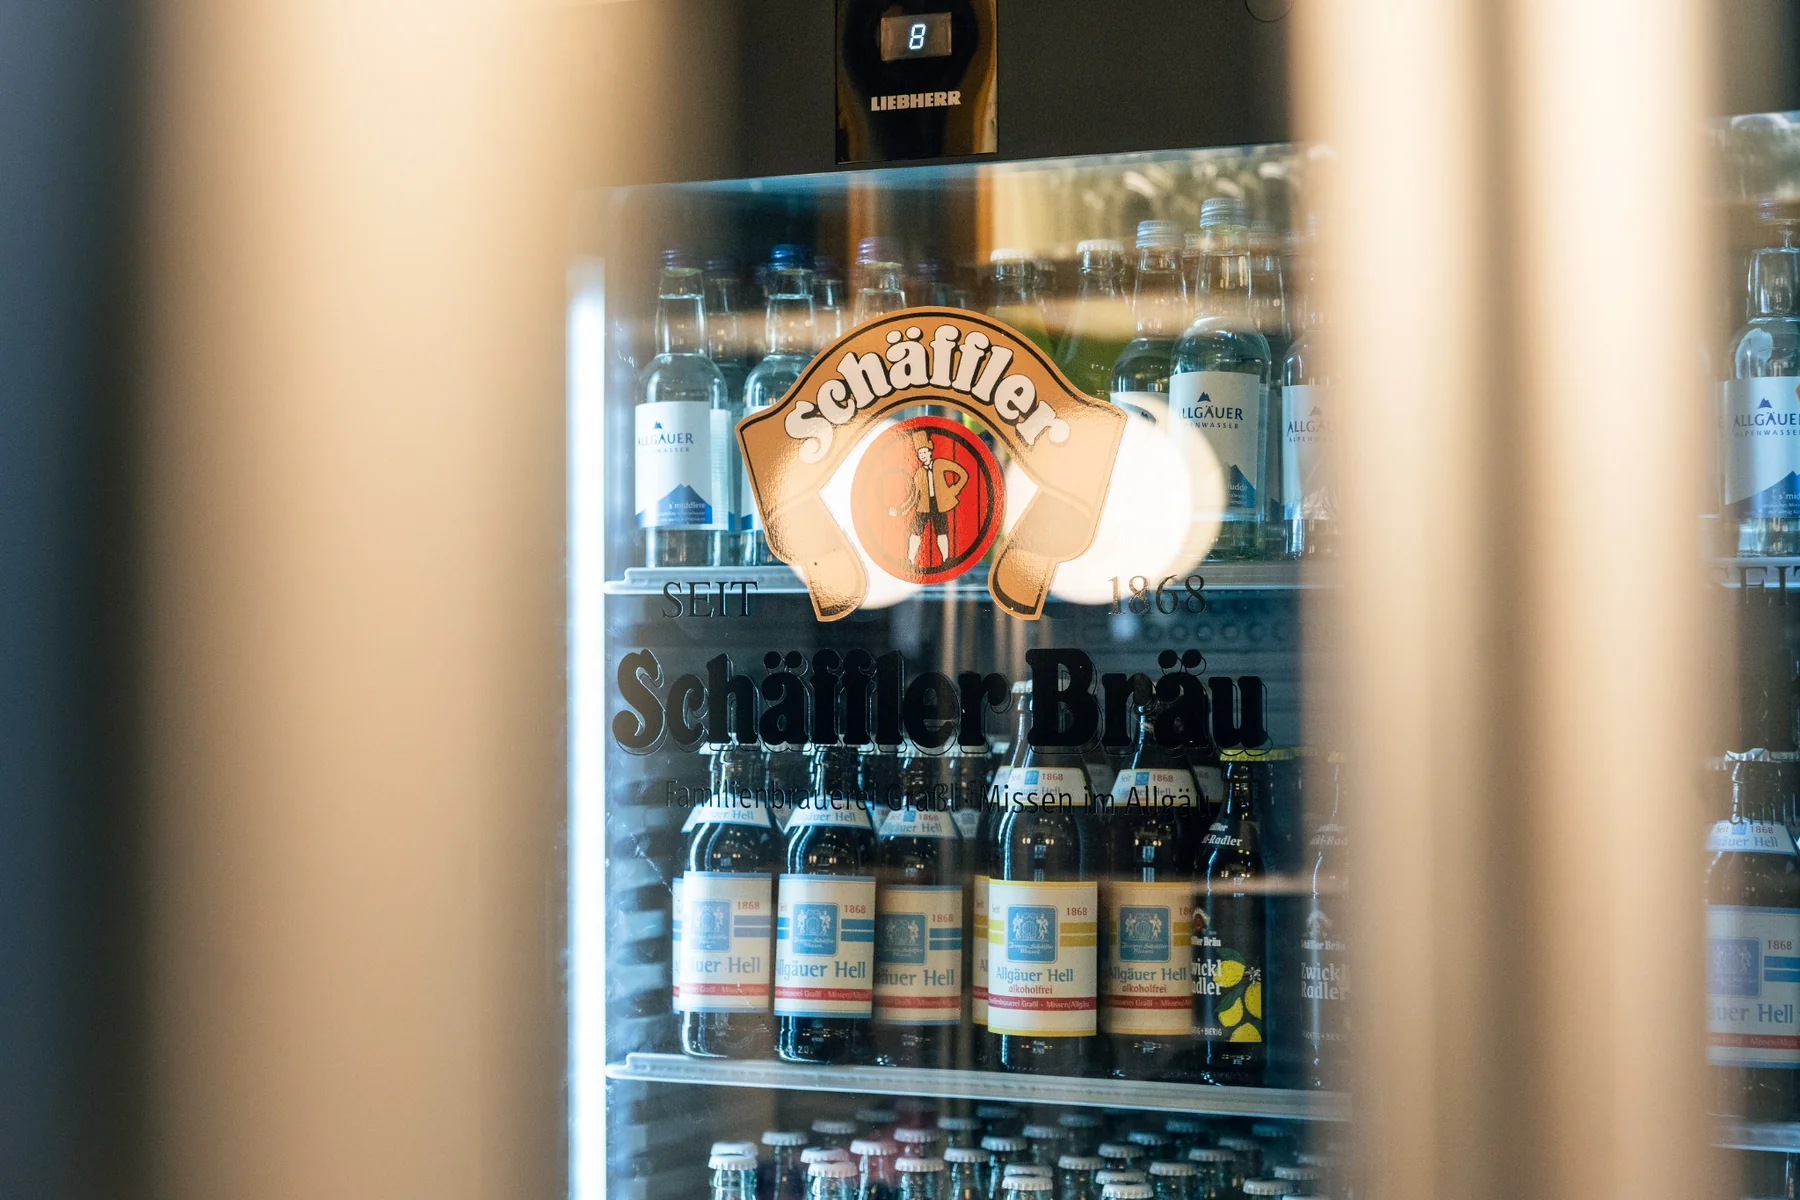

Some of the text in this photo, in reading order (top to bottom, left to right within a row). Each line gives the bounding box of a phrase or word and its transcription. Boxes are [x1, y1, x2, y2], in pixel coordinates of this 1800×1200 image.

[909, 24, 926, 50] 8
[870, 90, 962, 112] LIEBHERR
[784, 324, 1071, 464] Schäffler
[662, 574, 1208, 619] SEIT 1868
[612, 648, 1274, 758] Schäffler Bräu
[664, 780, 877, 811] Familienbrauerei
[980, 784, 1074, 814] Missen
[1083, 785, 1117, 816] im
[1124, 785, 1211, 823] Allgäu
[844, 904, 867, 914] 1868
[1066, 906, 1088, 917] 1868
[1767, 940, 1793, 950] 1868
[727, 956, 760, 974] Hell
[833, 960, 867, 979] Hell
[1161, 967, 1187, 981] Hell
[923, 968, 955, 986] Hell
[995, 966, 1043, 984] Allgäuer
[1046, 968, 1075, 982] Hell
[1008, 983, 1054, 995] alkoholfrei
[1757, 1003, 1794, 1024] Hell
